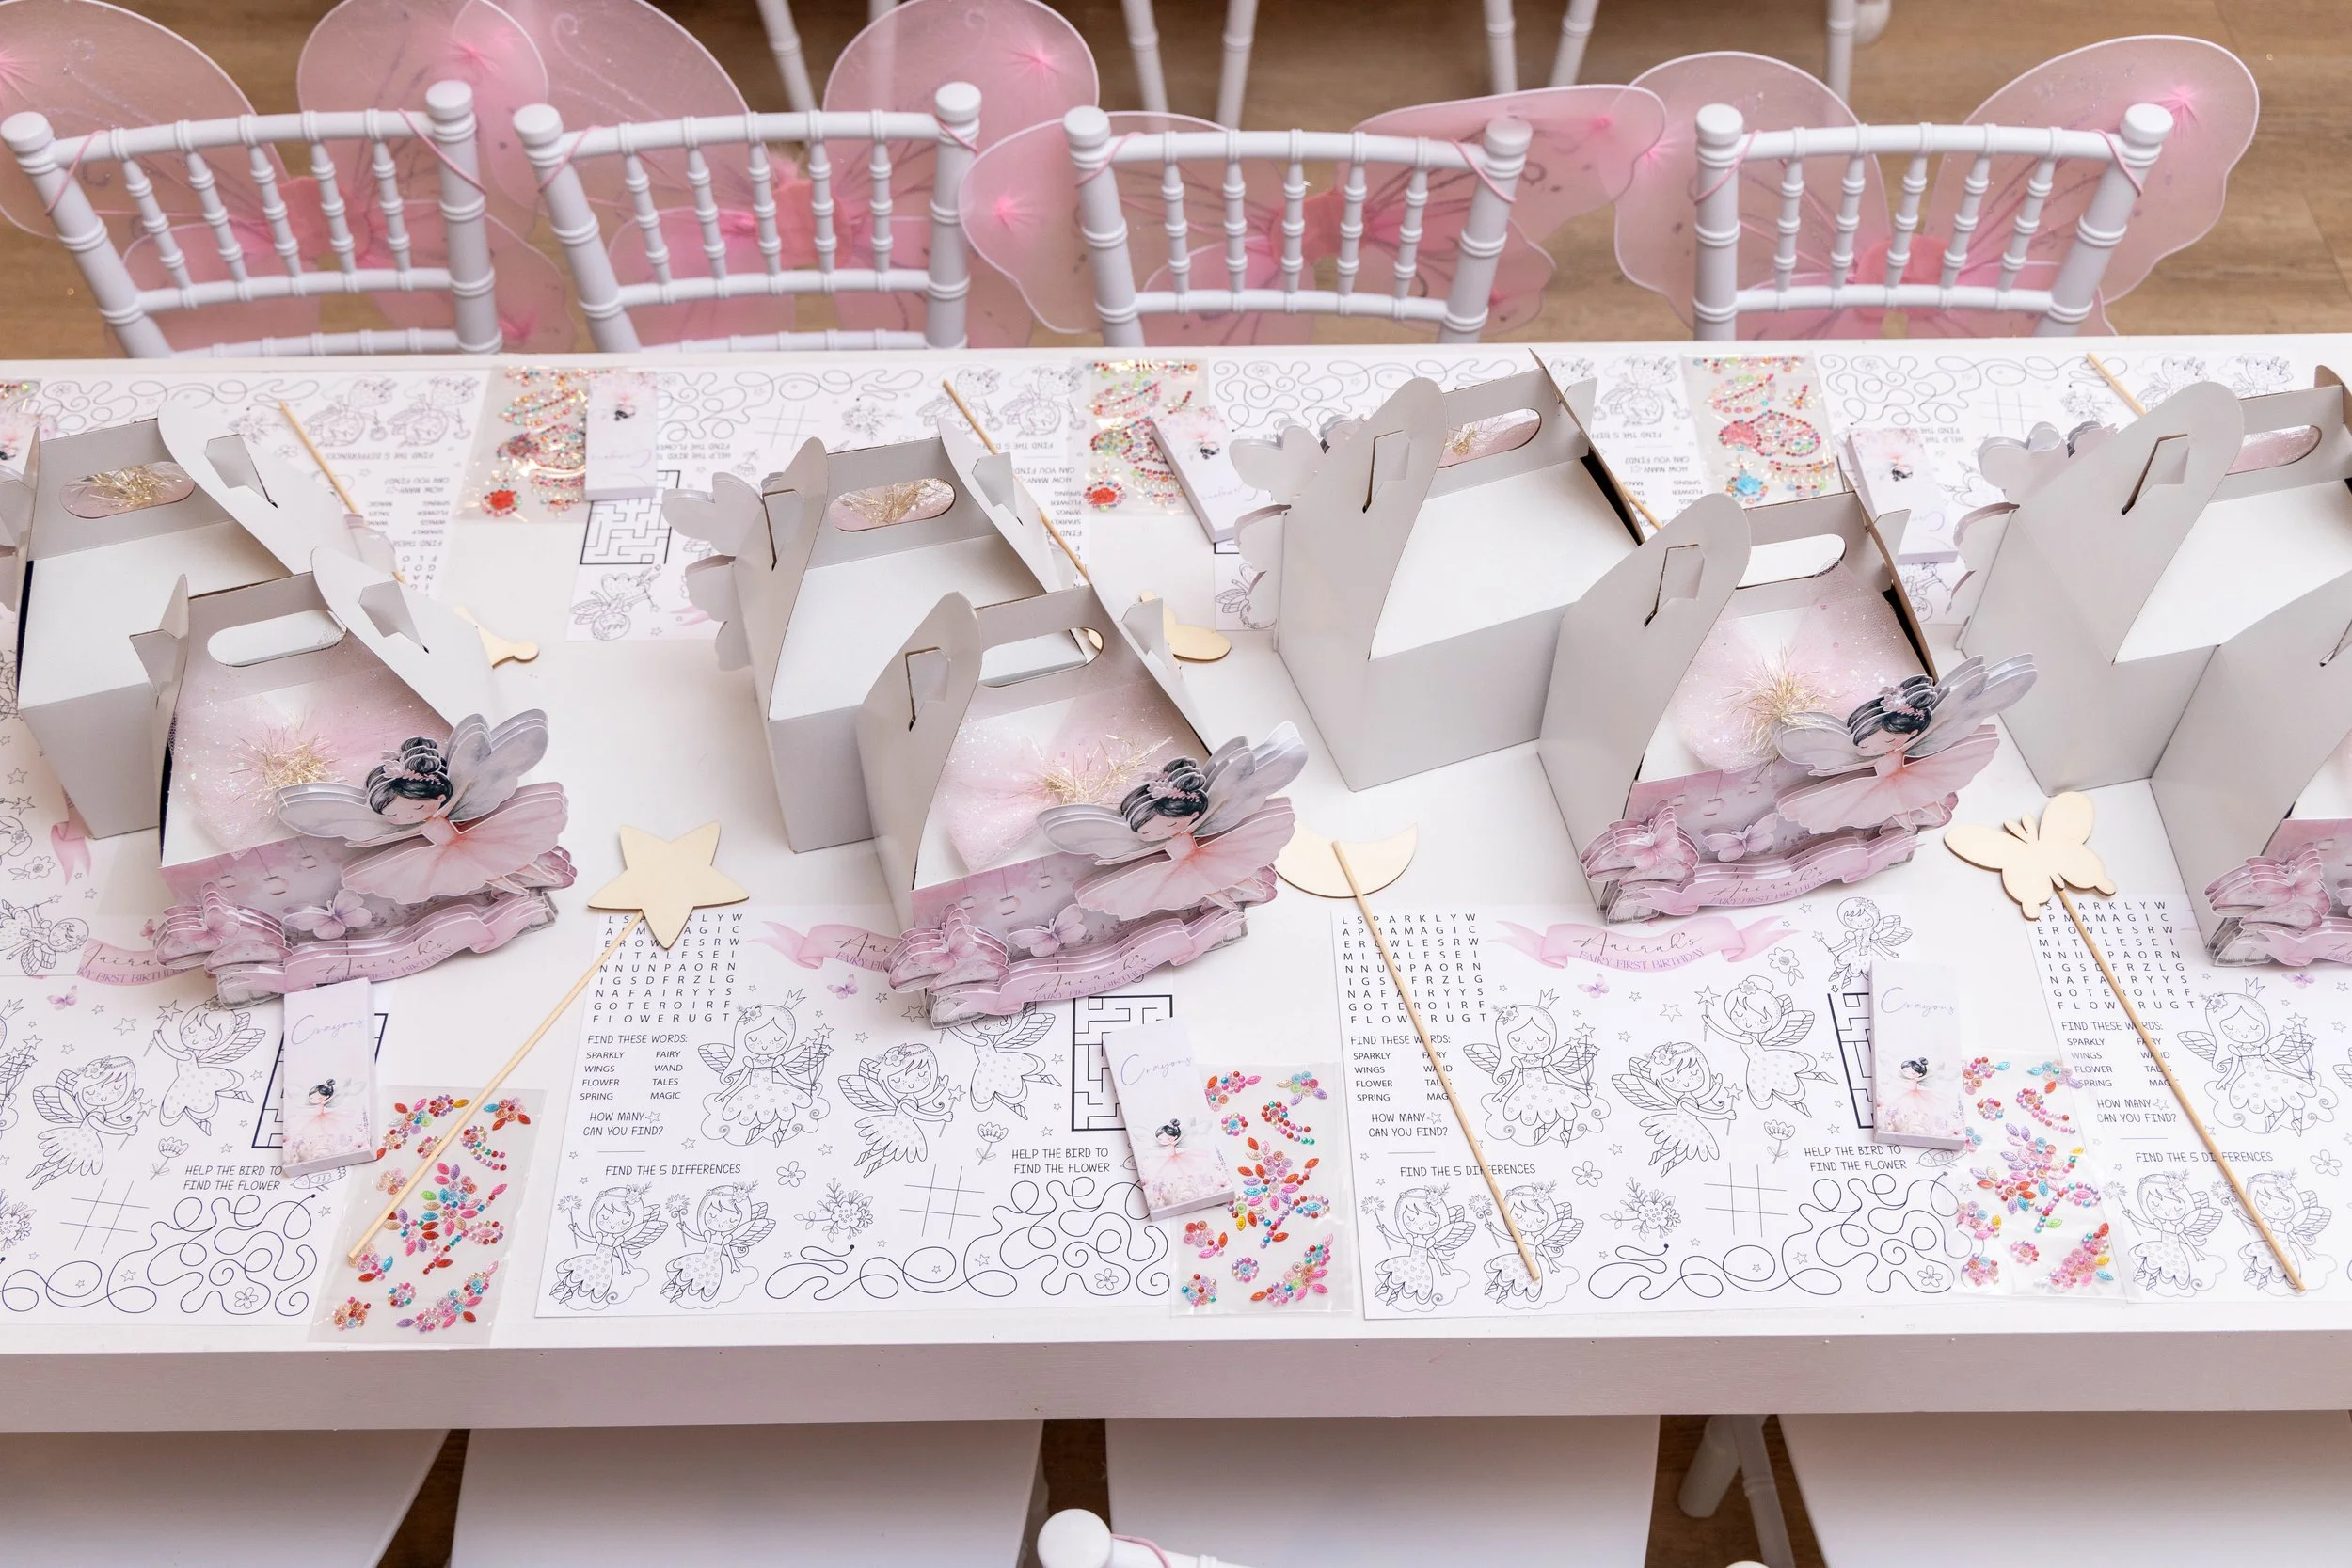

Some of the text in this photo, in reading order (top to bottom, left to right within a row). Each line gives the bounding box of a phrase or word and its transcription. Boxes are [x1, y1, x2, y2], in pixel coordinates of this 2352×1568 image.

[1579, 946, 1707, 970] FAIRY FIRST BIRTHDAY
[1881, 987, 1956, 1018] Crayons
[2061, 1021, 2164, 1031] FIND THESE WRDS:
[587, 1034, 688, 1044] FIND THESE WORDS:
[1350, 1034, 1451, 1045] FIND THESE WRDS:
[2067, 1037, 2105, 1046] SPARKLY
[1353, 1052, 1391, 1060] SPARKLY
[1422, 1051, 1447, 1059] FARY
[2070, 1052, 2103, 1060] WINGS
[584, 1065, 615, 1073] WINGS
[654, 1064, 683, 1072] WAND
[1120, 1053, 1192, 1086] Crayons
[1354, 1066, 1386, 1074] WINGS
[652, 1078, 679, 1086] TALES
[2149, 1079, 2179, 1087] MAG
[580, 1092, 613, 1101] SPRING
[650, 1091, 681, 1100] MAGIC
[1357, 1093, 1391, 1101] SPRING
[1426, 1091, 1457, 1101] MAG
[2096, 1099, 2152, 1109] HOW MANY
[589, 1112, 645, 1121] HOW MANY
[1372, 1113, 1426, 1123] HOW MANY
[2096, 1113, 2177, 1123] CAN YOU FIND?
[582, 1125, 664, 1136] CAN YOU FIND?
[1368, 1127, 1448, 1137] CAN YOU FIND?
[1011, 1147, 1109, 1160] HELP THE BIRD TO
[1804, 1144, 1901, 1157] HELP THE BIRD TO
[2136, 1152, 2164, 1163] FIND
[2167, 1152, 2186, 1163] THE
[2190, 1152, 2199, 1162] 5
[184, 1164, 283, 1176] HELP THE BIRD TO
[605, 1164, 741, 1176] FIND THE 5 DIFFERENCES
[1013, 1163, 1110, 1174] FIND THE FLOWER
[1400, 1166, 1427, 1177] FIND
[1431, 1165, 1451, 1176] THE
[1454, 1165, 1462, 1176] 5
[1809, 1160, 1907, 1172] FIND THE FLOWER
[183, 1180, 281, 1191] FIND THE FLOWER
